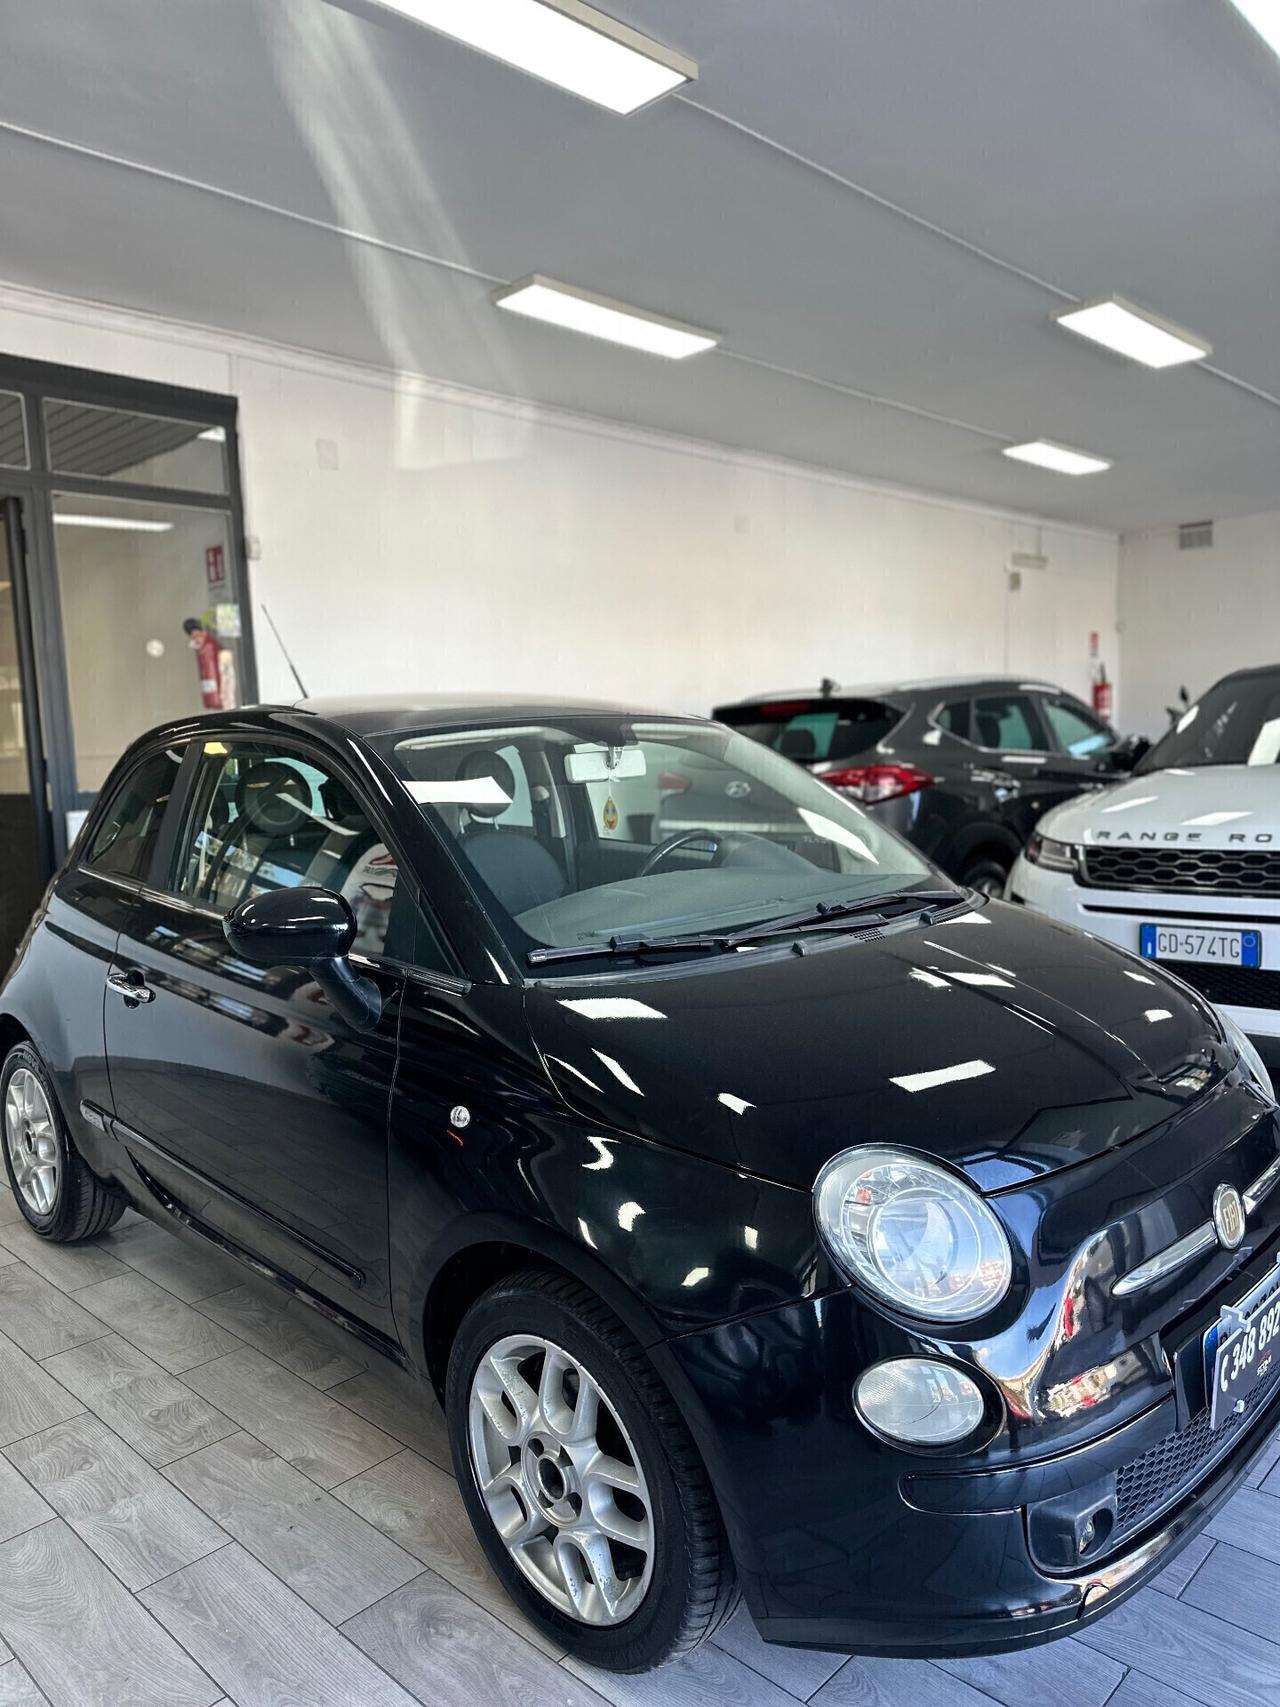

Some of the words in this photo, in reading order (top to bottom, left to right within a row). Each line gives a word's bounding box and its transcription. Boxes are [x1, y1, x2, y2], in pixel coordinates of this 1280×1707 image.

[1097, 831, 1202, 842] RANGE
[1223, 1201, 1239, 1234] FIAT
[1231, 1327, 1256, 1380] 348
